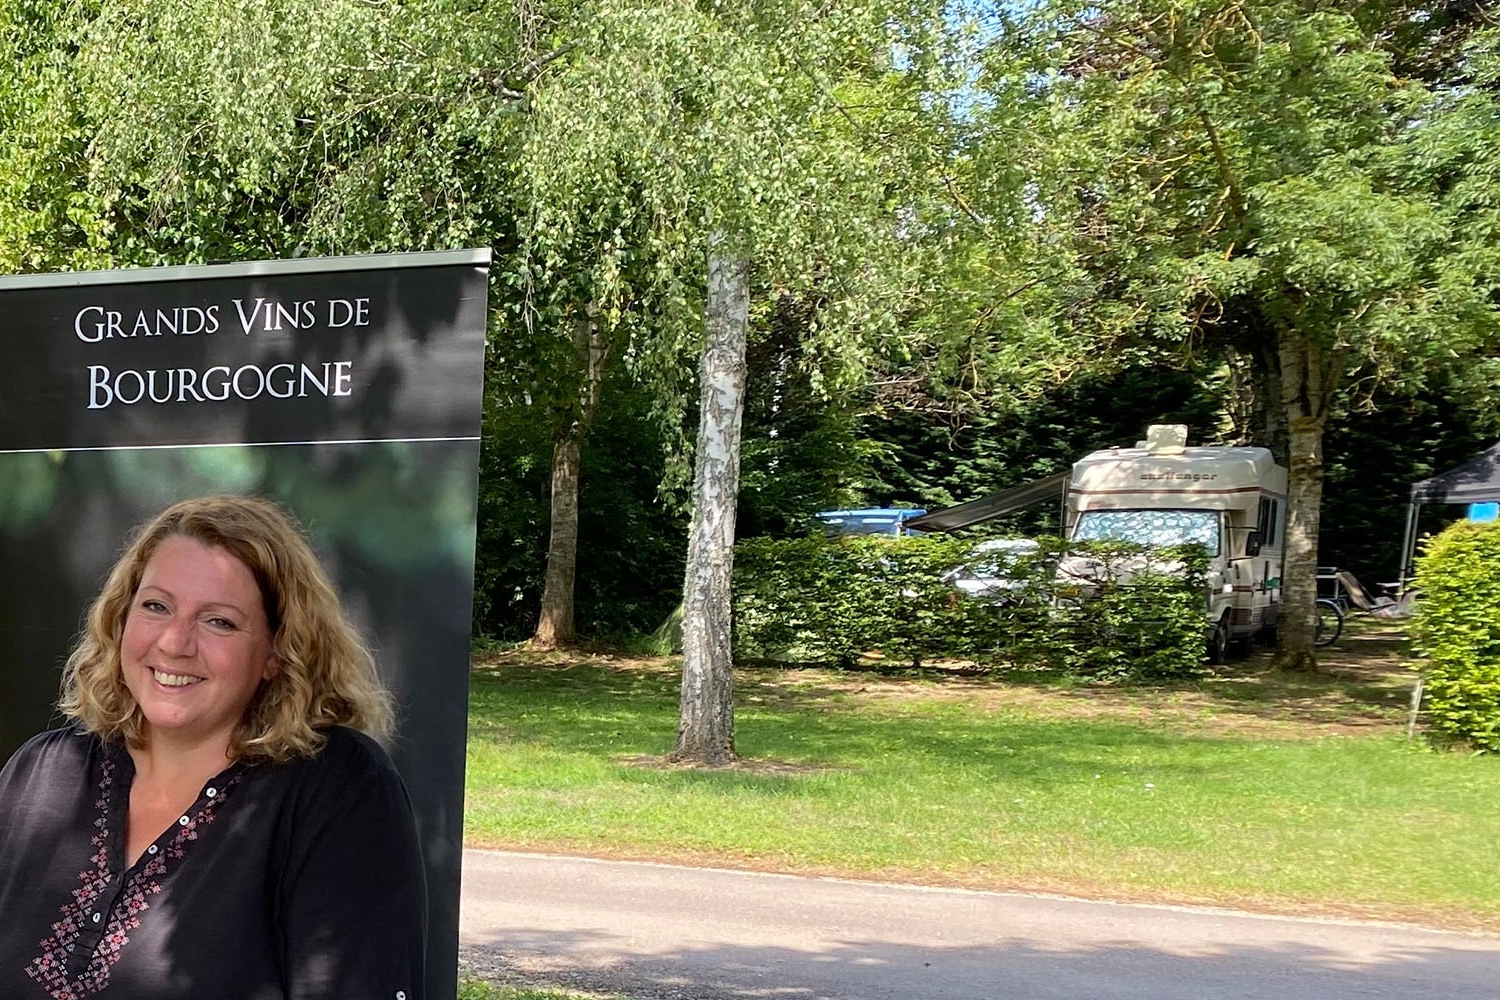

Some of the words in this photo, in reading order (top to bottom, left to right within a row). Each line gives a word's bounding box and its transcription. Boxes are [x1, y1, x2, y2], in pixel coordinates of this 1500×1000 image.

[74, 305, 219, 343] GRANDS
[232, 298, 316, 335] VINS
[328, 298, 370, 328] DE
[87, 361, 353, 410] BOURGOGNE
